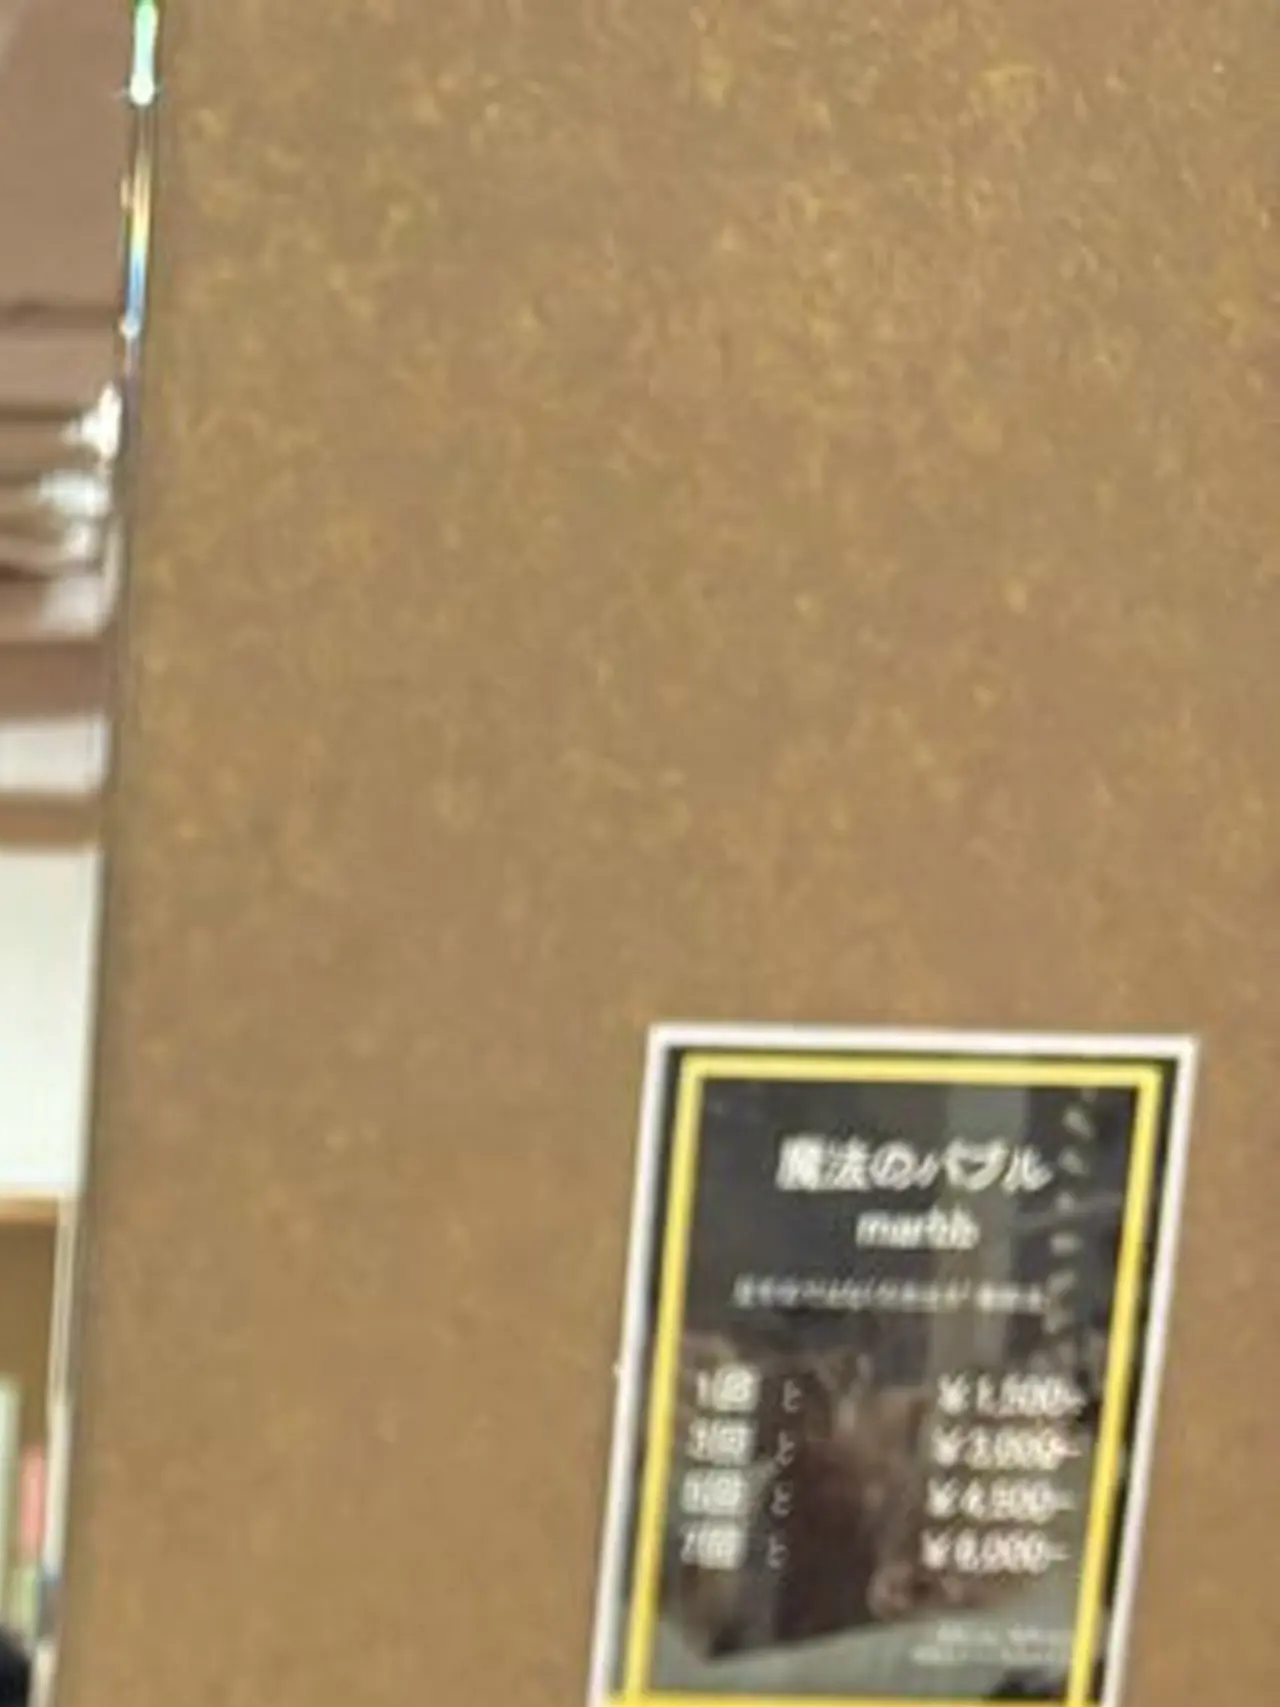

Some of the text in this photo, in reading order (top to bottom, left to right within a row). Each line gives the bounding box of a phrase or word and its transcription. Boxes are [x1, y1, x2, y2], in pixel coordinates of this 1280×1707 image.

[776, 1133, 1054, 1193] 魔法のバブル
